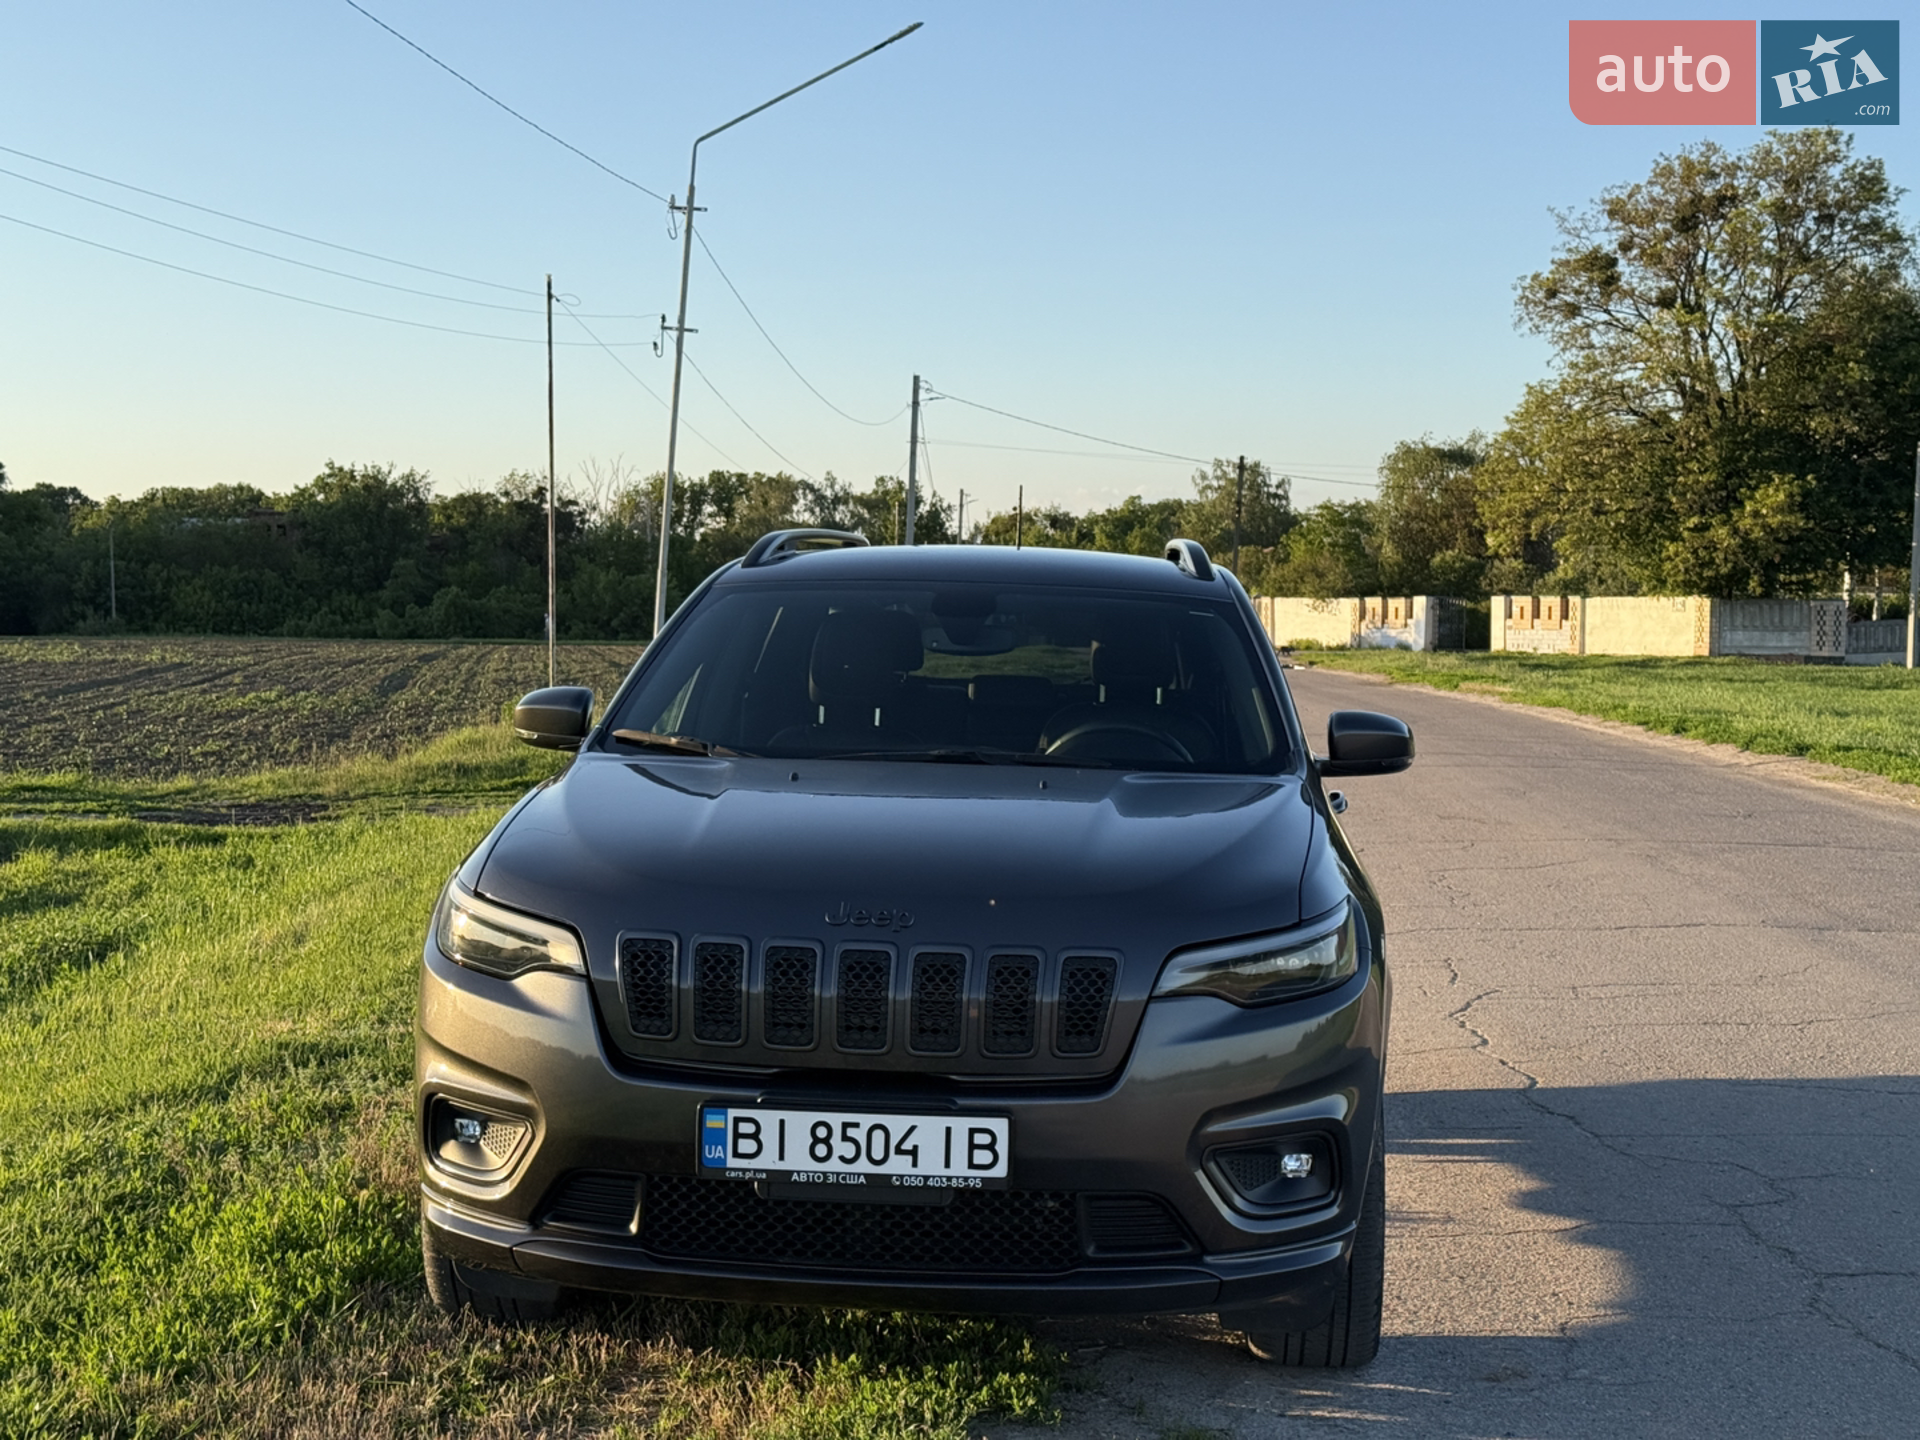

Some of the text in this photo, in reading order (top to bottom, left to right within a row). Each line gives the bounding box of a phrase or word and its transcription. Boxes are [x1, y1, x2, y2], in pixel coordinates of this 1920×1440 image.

[824, 901, 915, 933] Jeep
[731, 1116, 1000, 1171] BI 8504 IB
[704, 1144, 725, 1160] UA
[791, 1172, 825, 1183] АВТО
[838, 1174, 867, 1185] США
[903, 1176, 982, 1188] 050 403-85-95
